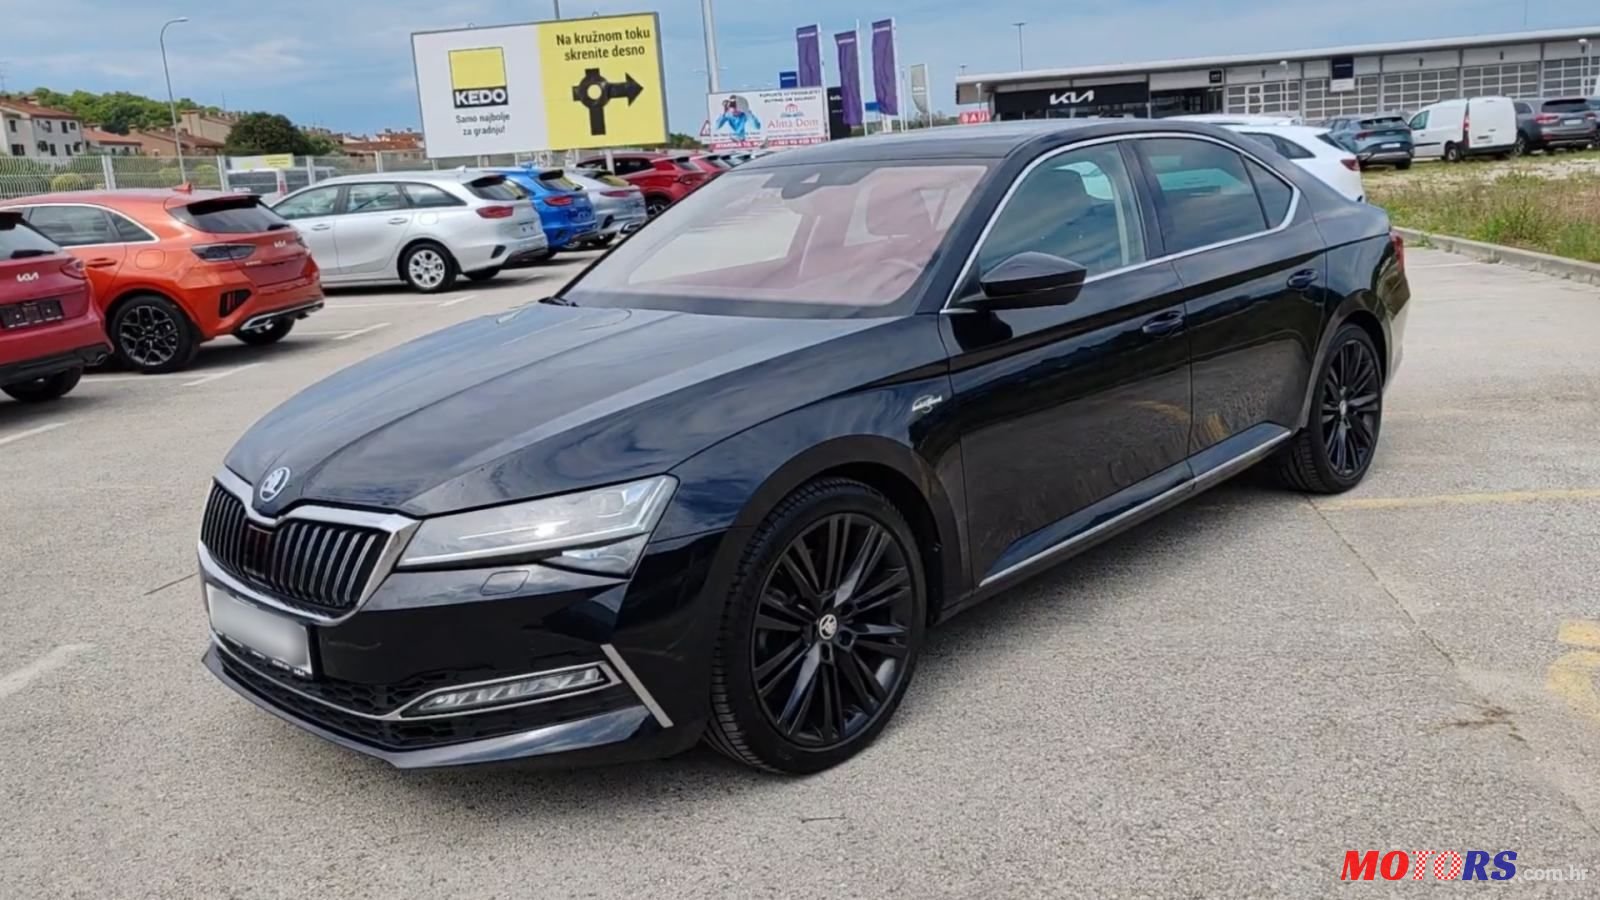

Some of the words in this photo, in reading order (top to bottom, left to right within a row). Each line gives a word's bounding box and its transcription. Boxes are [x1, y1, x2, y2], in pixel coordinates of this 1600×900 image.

[556, 33, 572, 46] Na
[574, 30, 622, 44] kružnom
[625, 28, 651, 41] toku
[564, 47, 610, 61] skrenite
[612, 44, 646, 57] desno
[454, 89, 507, 106] KEDO
[1049, 90, 1094, 105] KIA
[456, 114, 477, 124] Samo
[479, 112, 510, 124] najbolje
[795, 117, 819, 128] Dom
[463, 128, 473, 136] za
[474, 126, 506, 137] gradnju!
